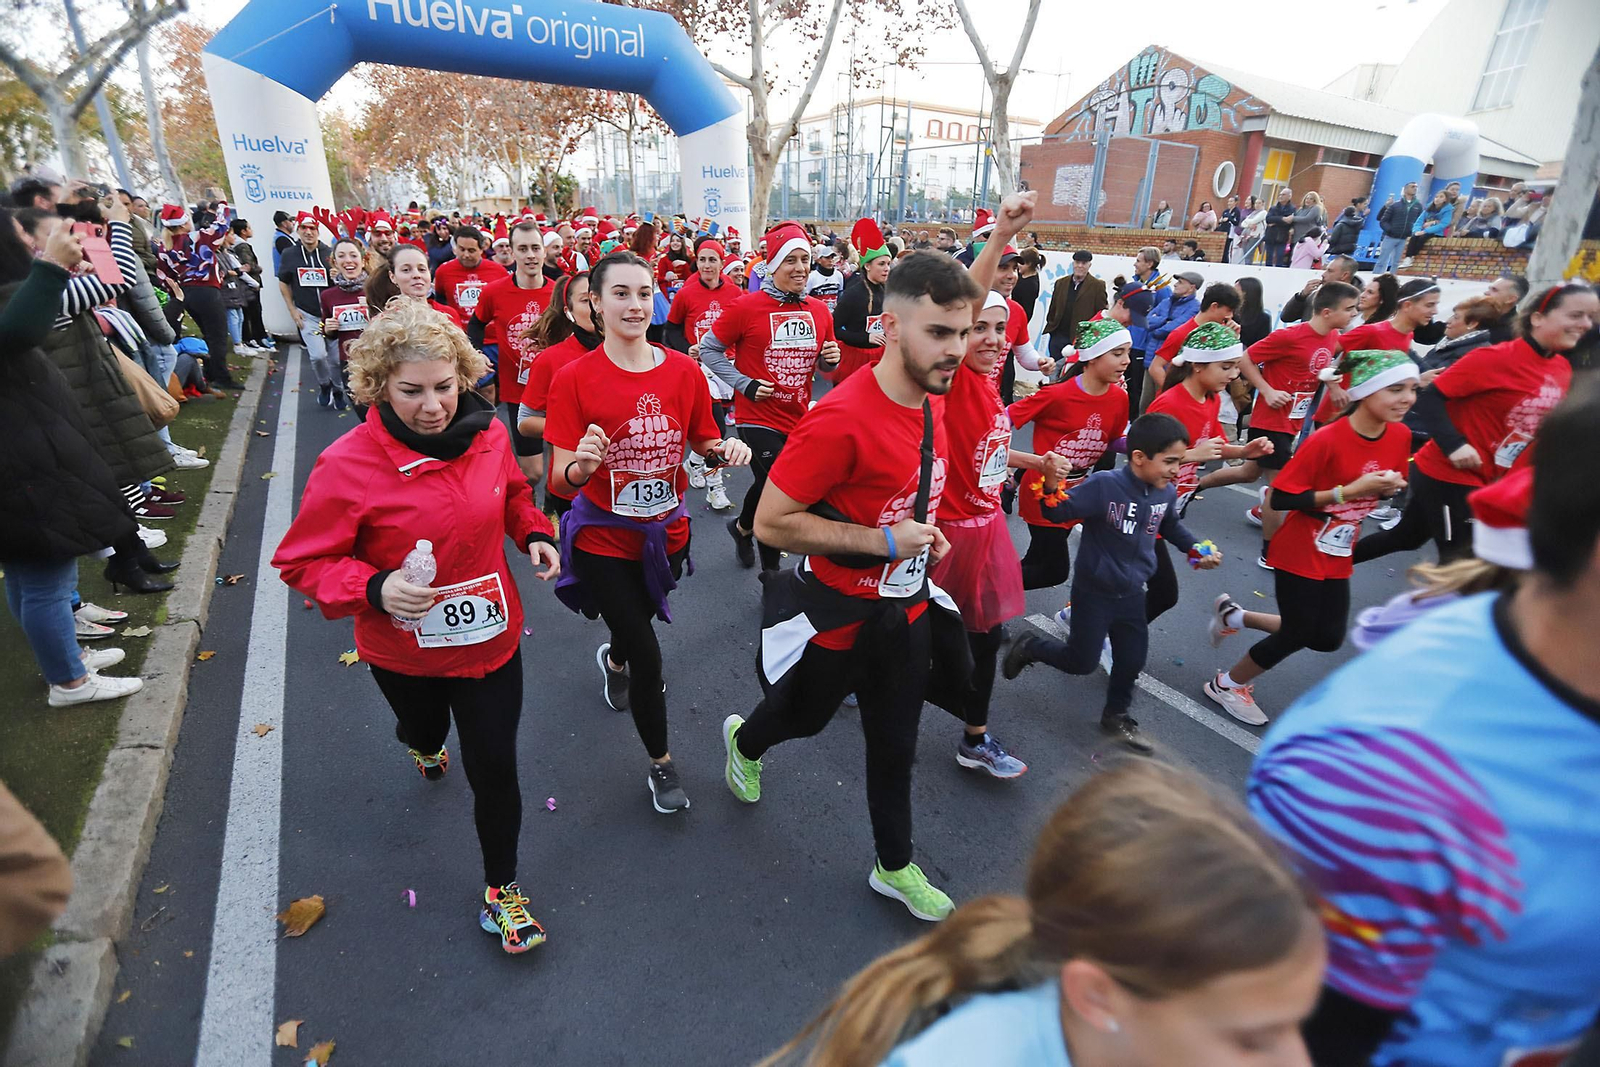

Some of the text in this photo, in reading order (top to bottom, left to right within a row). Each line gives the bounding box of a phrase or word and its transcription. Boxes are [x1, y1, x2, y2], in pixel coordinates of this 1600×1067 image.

[366, 0, 645, 59] Huelva original
[232, 133, 306, 155] Huelva
[702, 164, 745, 179] Huelva
[270, 190, 314, 201] HUELVA
[305, 272, 320, 281] 215
[342, 311, 359, 323] 217
[783, 321, 806, 336] 179
[628, 414, 669, 435] XIII
[609, 429, 682, 453] CARRERA
[605, 448, 635, 463] SAN
[631, 481, 664, 502] 133
[443, 600, 476, 627] 89
